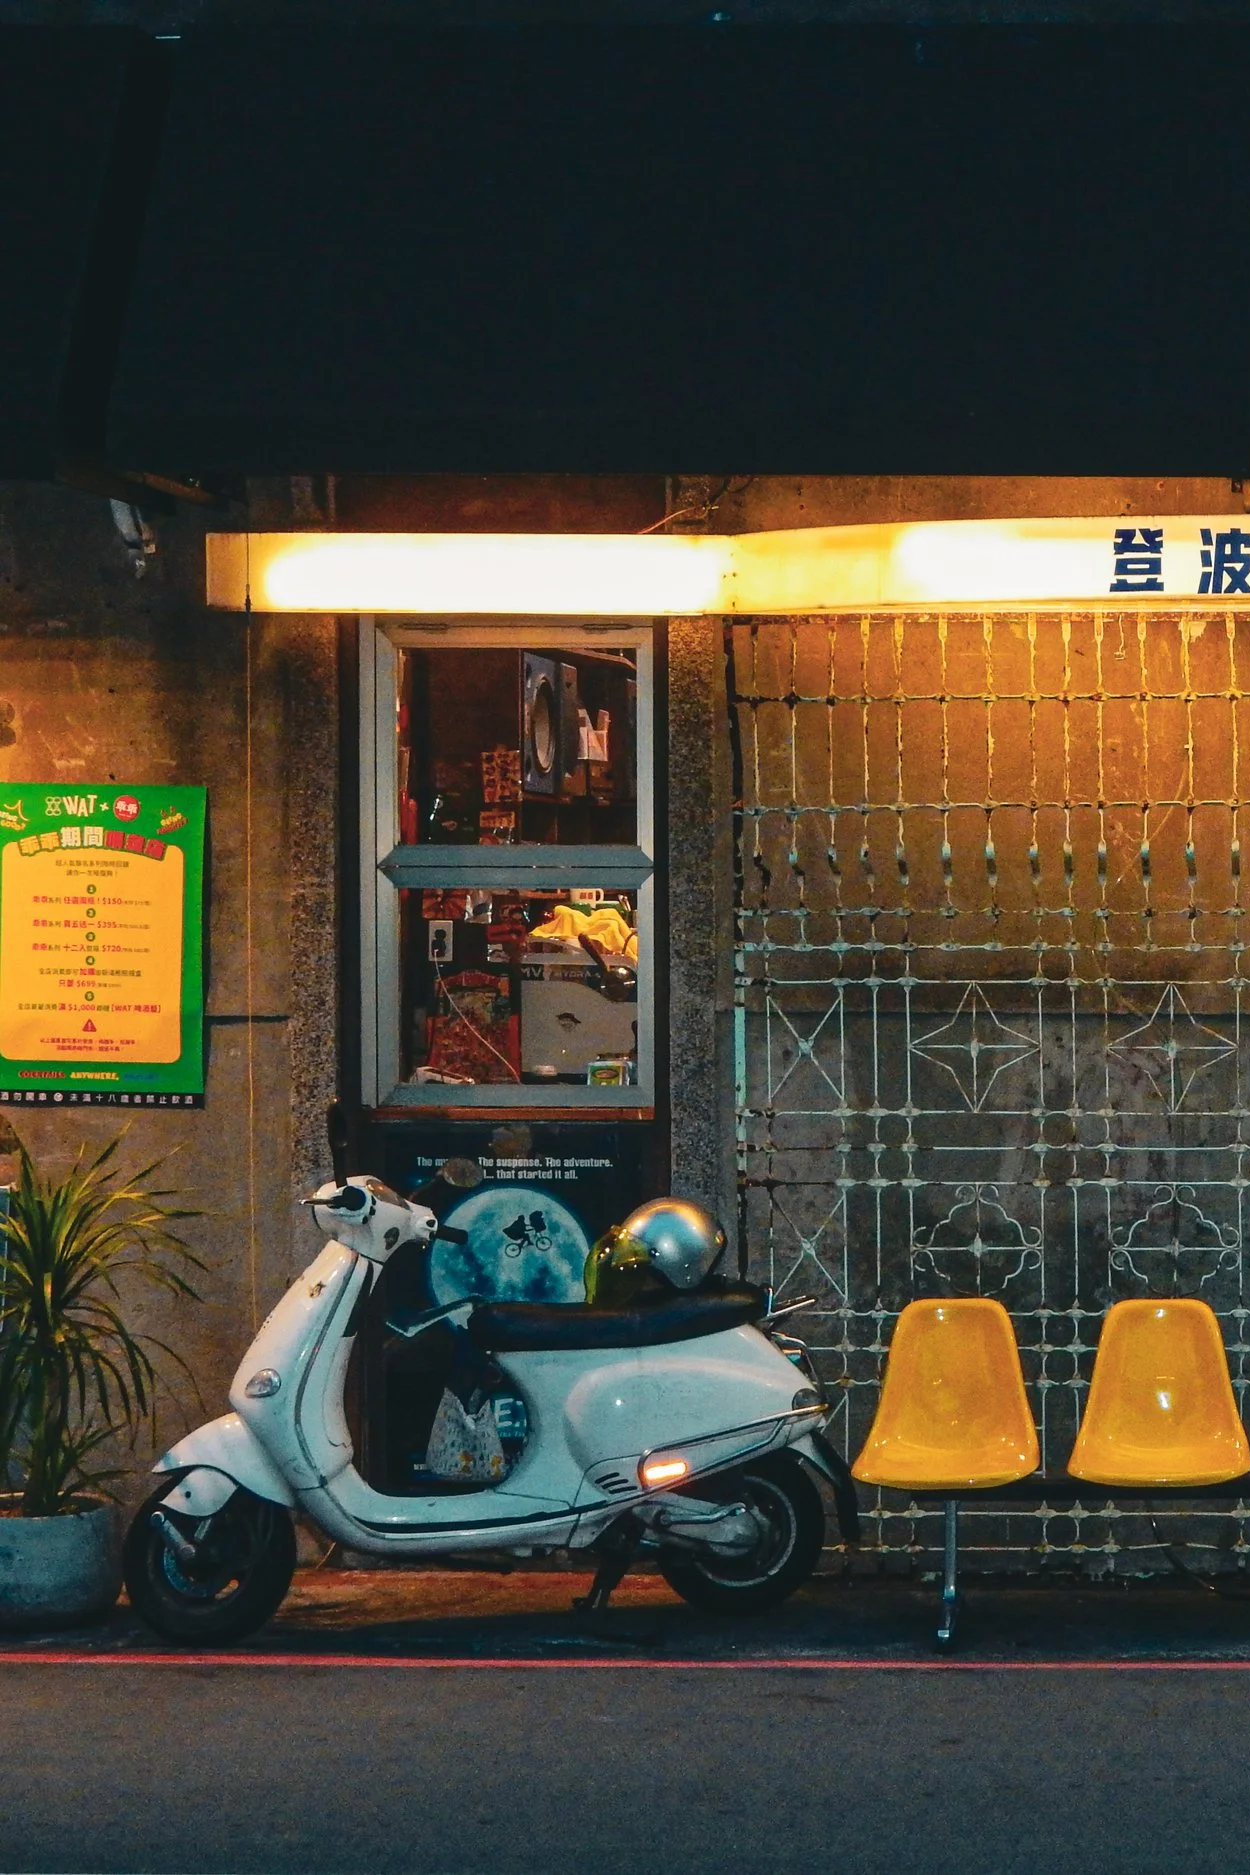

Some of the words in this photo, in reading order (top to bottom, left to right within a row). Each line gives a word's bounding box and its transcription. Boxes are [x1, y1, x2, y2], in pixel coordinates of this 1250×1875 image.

[62, 794, 98, 817] WAT
[69, 1092, 194, 1105] 未滿十八歲者禁止飲酒
[416, 1156, 433, 1167] The
[478, 1156, 494, 1167] The
[496, 1157, 543, 1168] suspense.
[545, 1156, 561, 1167] The
[563, 1156, 614, 1168] adventure.
[496, 1169, 516, 1179] that
[517, 1169, 553, 1179] started
[554, 1169, 562, 1179] it
[564, 1169, 578, 1179] all.
